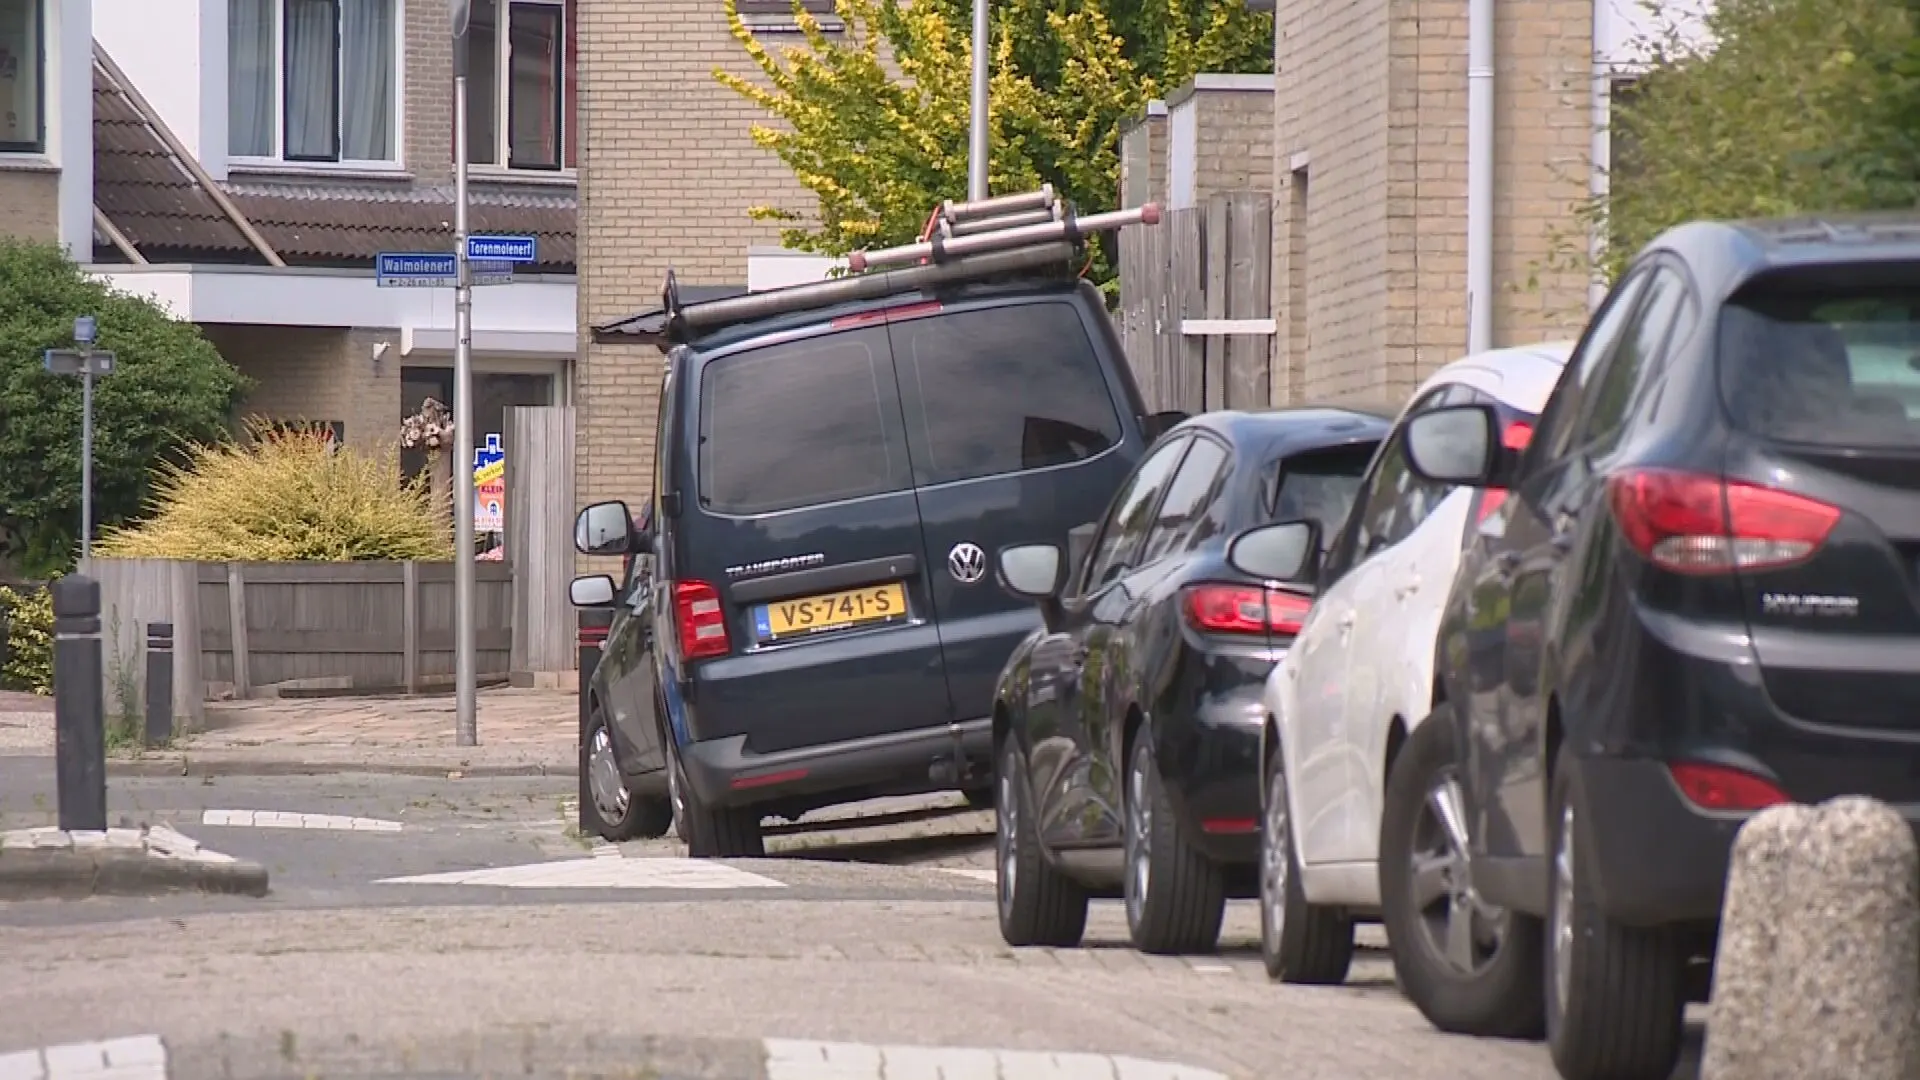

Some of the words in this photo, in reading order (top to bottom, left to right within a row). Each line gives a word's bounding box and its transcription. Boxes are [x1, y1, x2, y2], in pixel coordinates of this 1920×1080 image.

[470, 241, 531, 256] Torenmolenerf
[383, 258, 453, 273] Walmolenerf
[725, 553, 824, 577] TRANSPORTER
[780, 589, 891, 627] VS-741-S
